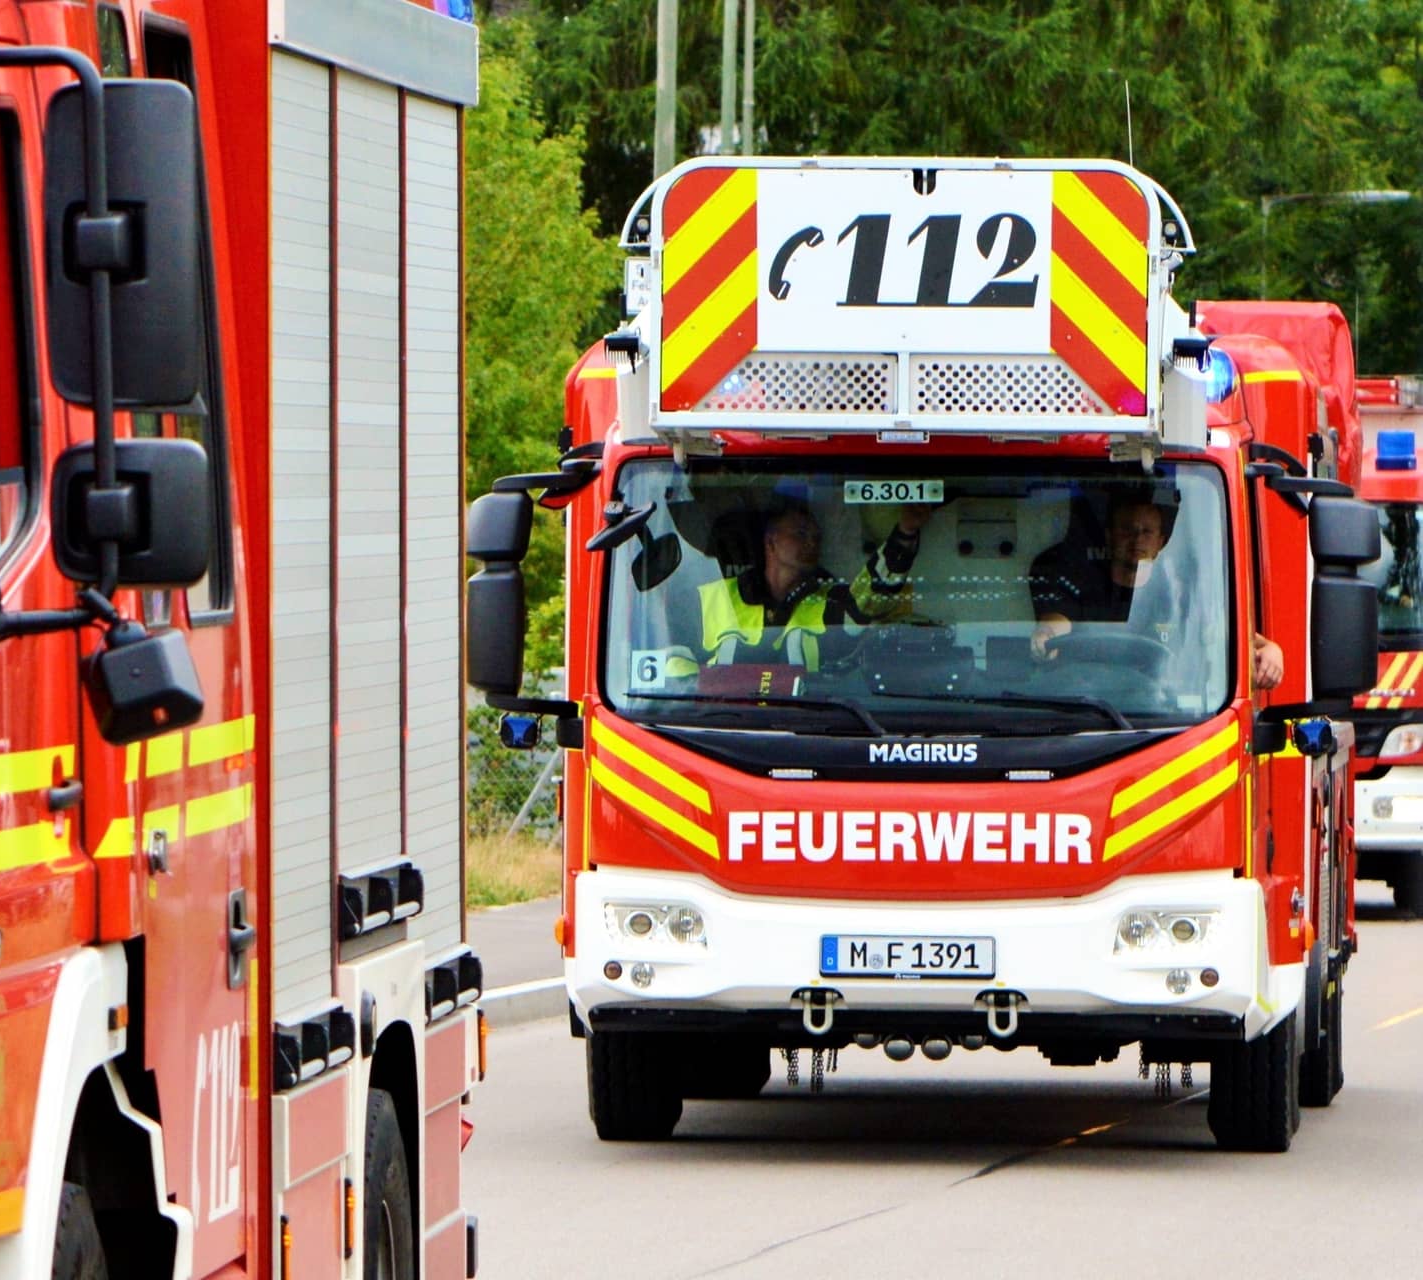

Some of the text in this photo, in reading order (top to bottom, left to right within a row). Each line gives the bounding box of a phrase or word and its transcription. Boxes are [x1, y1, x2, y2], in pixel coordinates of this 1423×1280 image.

[836, 212, 1039, 308] 112
[861, 483, 924, 500] 6.30.1
[639, 655, 658, 682] 6
[869, 743, 978, 762] MAGIRUS
[728, 811, 1092, 864] FEUERWEHR
[850, 942, 867, 967] M
[887, 943, 904, 968] F
[911, 943, 979, 969] 1391
[208, 1020, 240, 1223] 112
